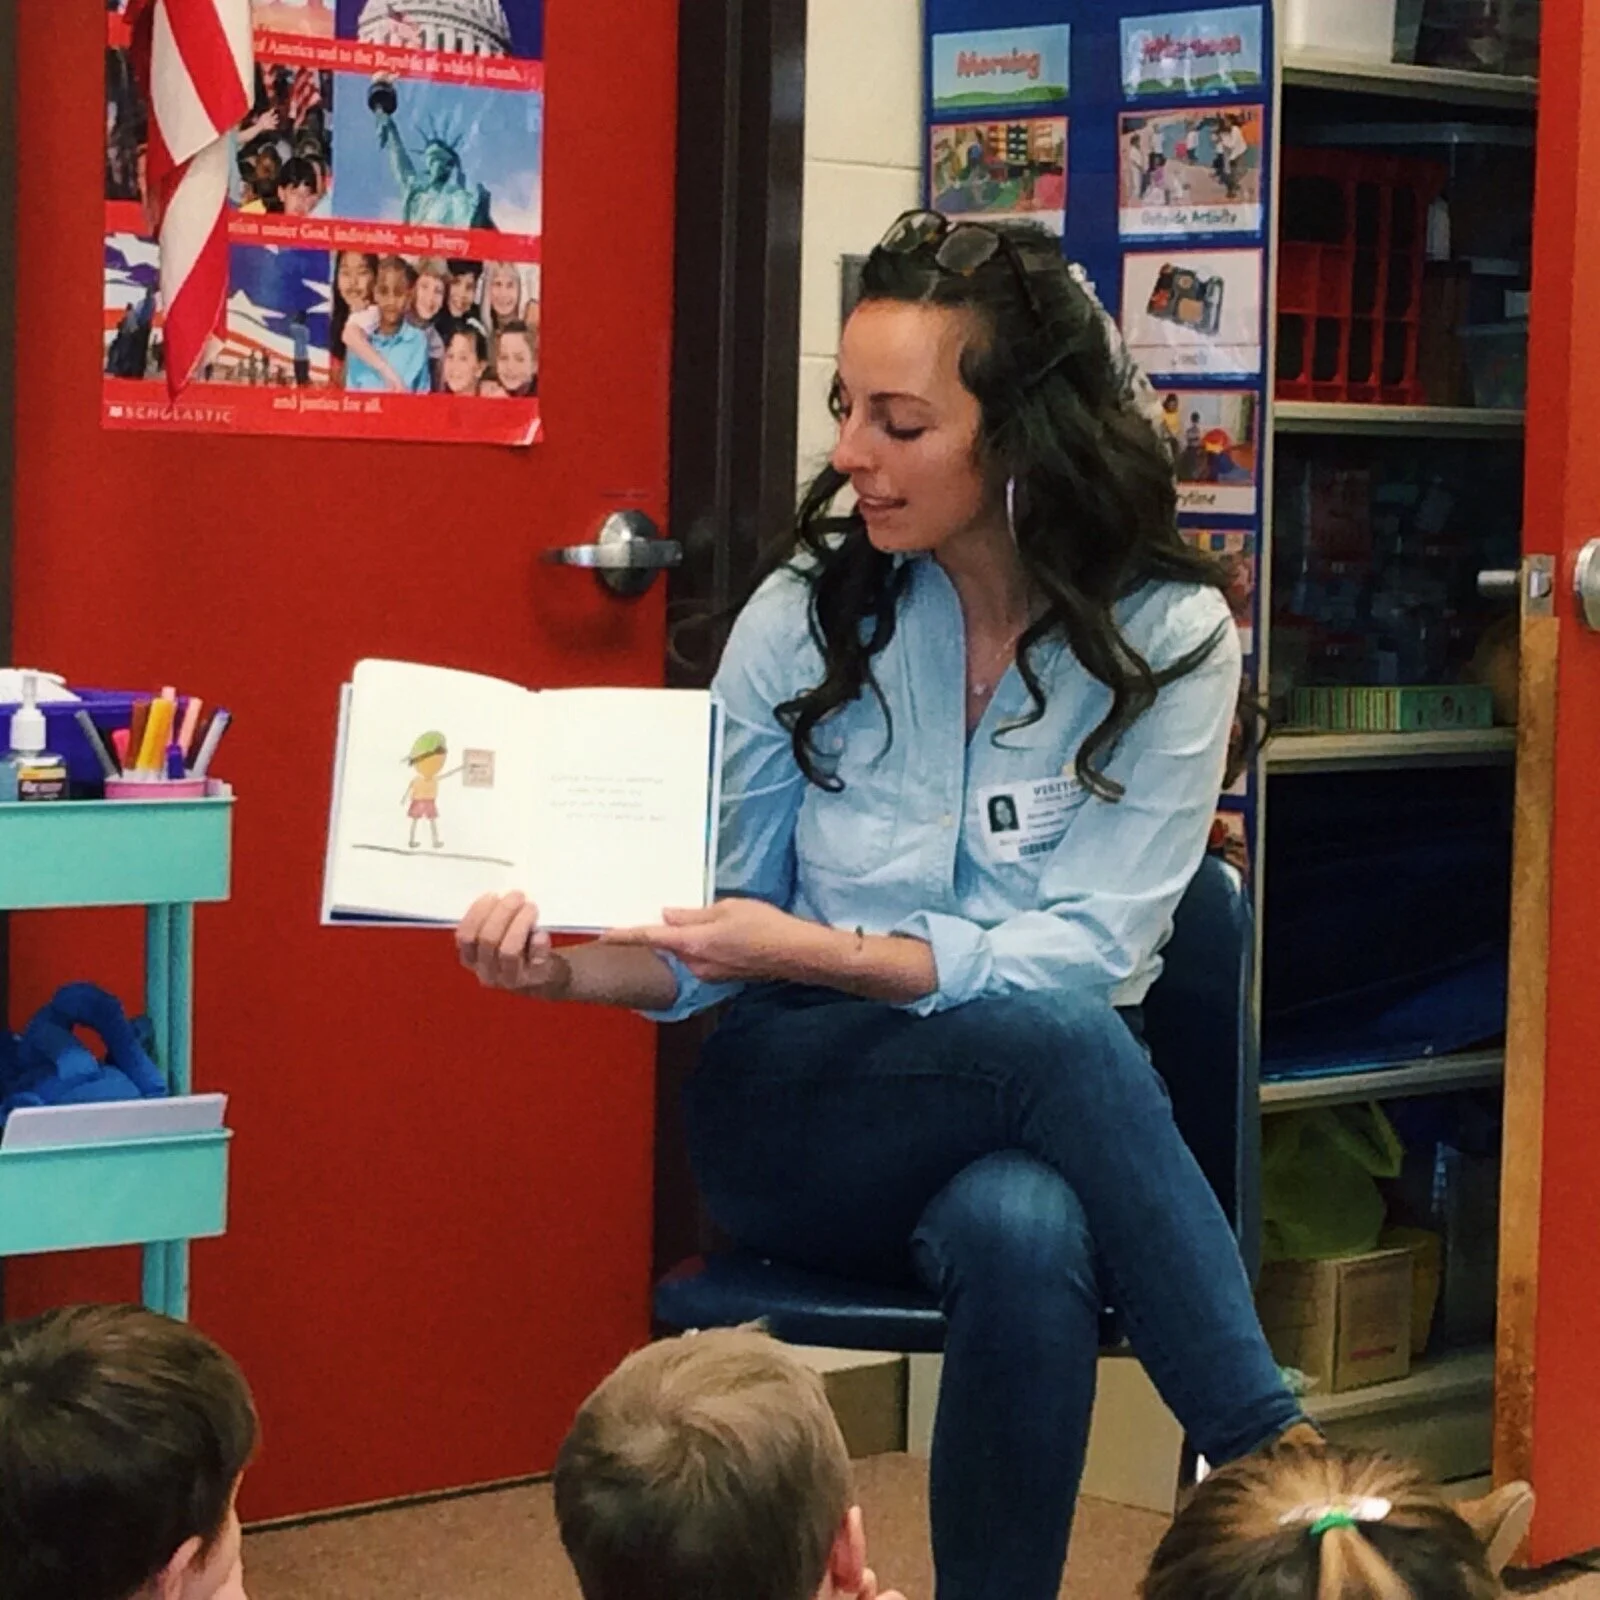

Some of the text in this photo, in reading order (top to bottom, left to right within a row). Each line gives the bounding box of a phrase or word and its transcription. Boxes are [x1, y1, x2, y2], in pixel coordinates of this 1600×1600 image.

[267, 40, 314, 58] America
[316, 45, 337, 60] and
[339, 48, 352, 61] to
[353, 49, 373, 65] the
[443, 58, 473, 76] which
[957, 48, 1040, 80] Morning
[262, 223, 298, 238] under
[403, 233, 429, 248] with
[432, 233, 470, 255] liberty
[125, 406, 232, 423] SCHOLASTIC
[273, 393, 297, 410] and
[299, 394, 339, 414] justice
[342, 395, 361, 412] for
[1033, 780, 1081, 798] VISIT
